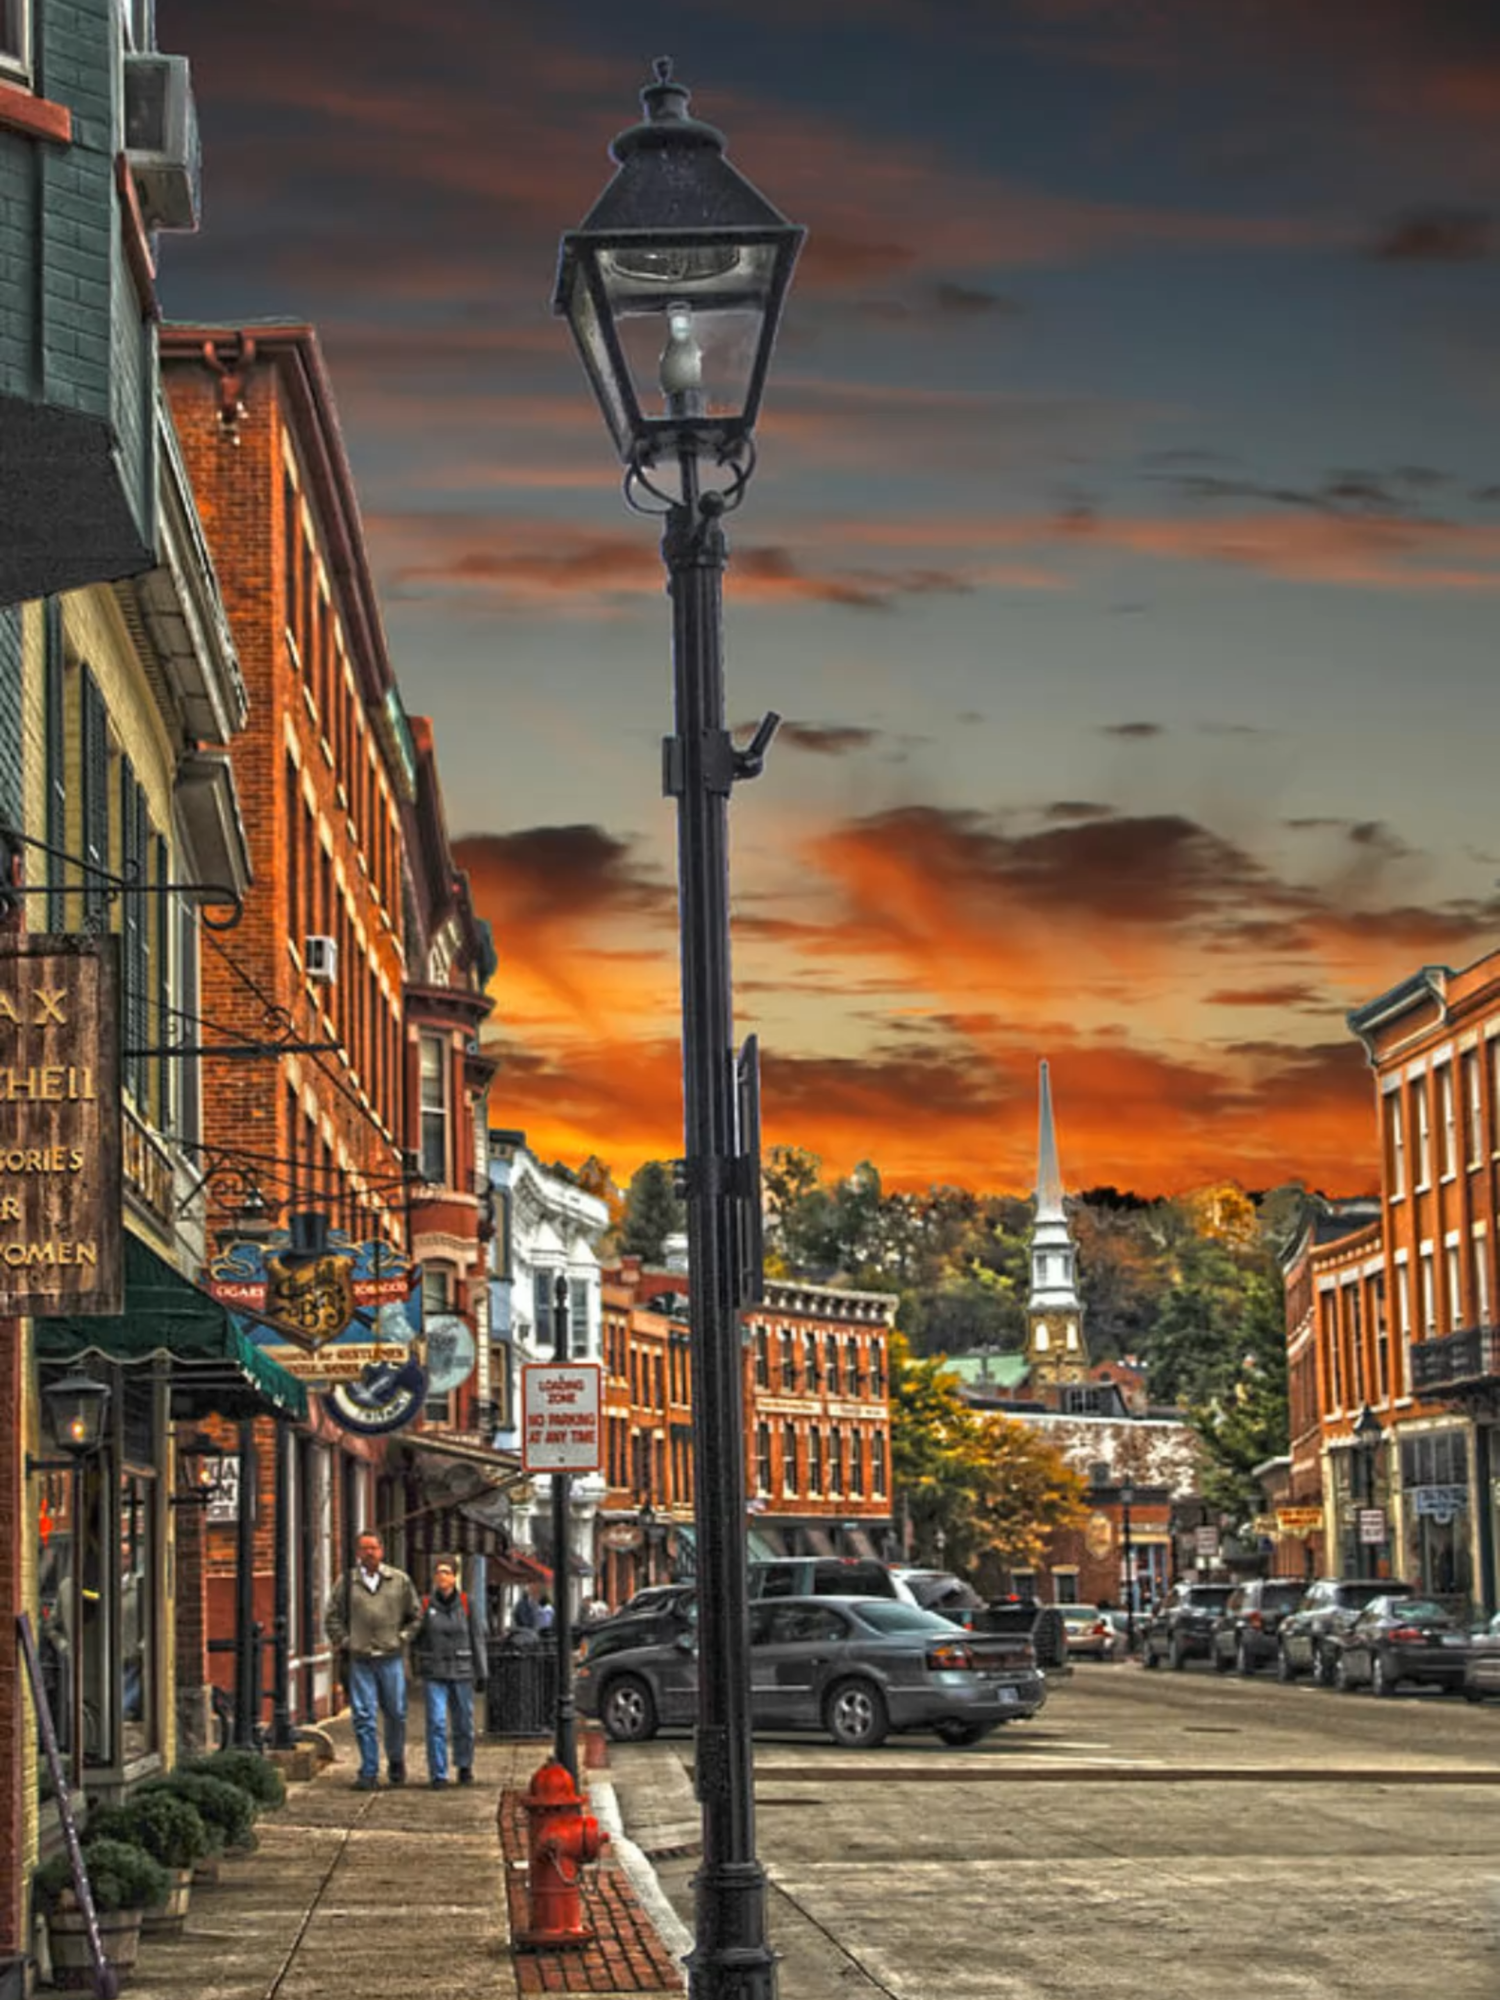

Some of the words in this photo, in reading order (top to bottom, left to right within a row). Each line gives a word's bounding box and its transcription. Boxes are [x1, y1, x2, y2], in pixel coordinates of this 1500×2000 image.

[0, 1197, 19, 1220] R
[0, 1242, 97, 1265] OMEN
[538, 1379, 584, 1392] LOADING
[548, 1393, 577, 1404] ZONE
[529, 1414, 544, 1426] NO
[548, 1413, 595, 1426] PARKING
[529, 1431, 542, 1444] AT
[545, 1431, 567, 1444] ANY
[571, 1430, 595, 1444] TIME
